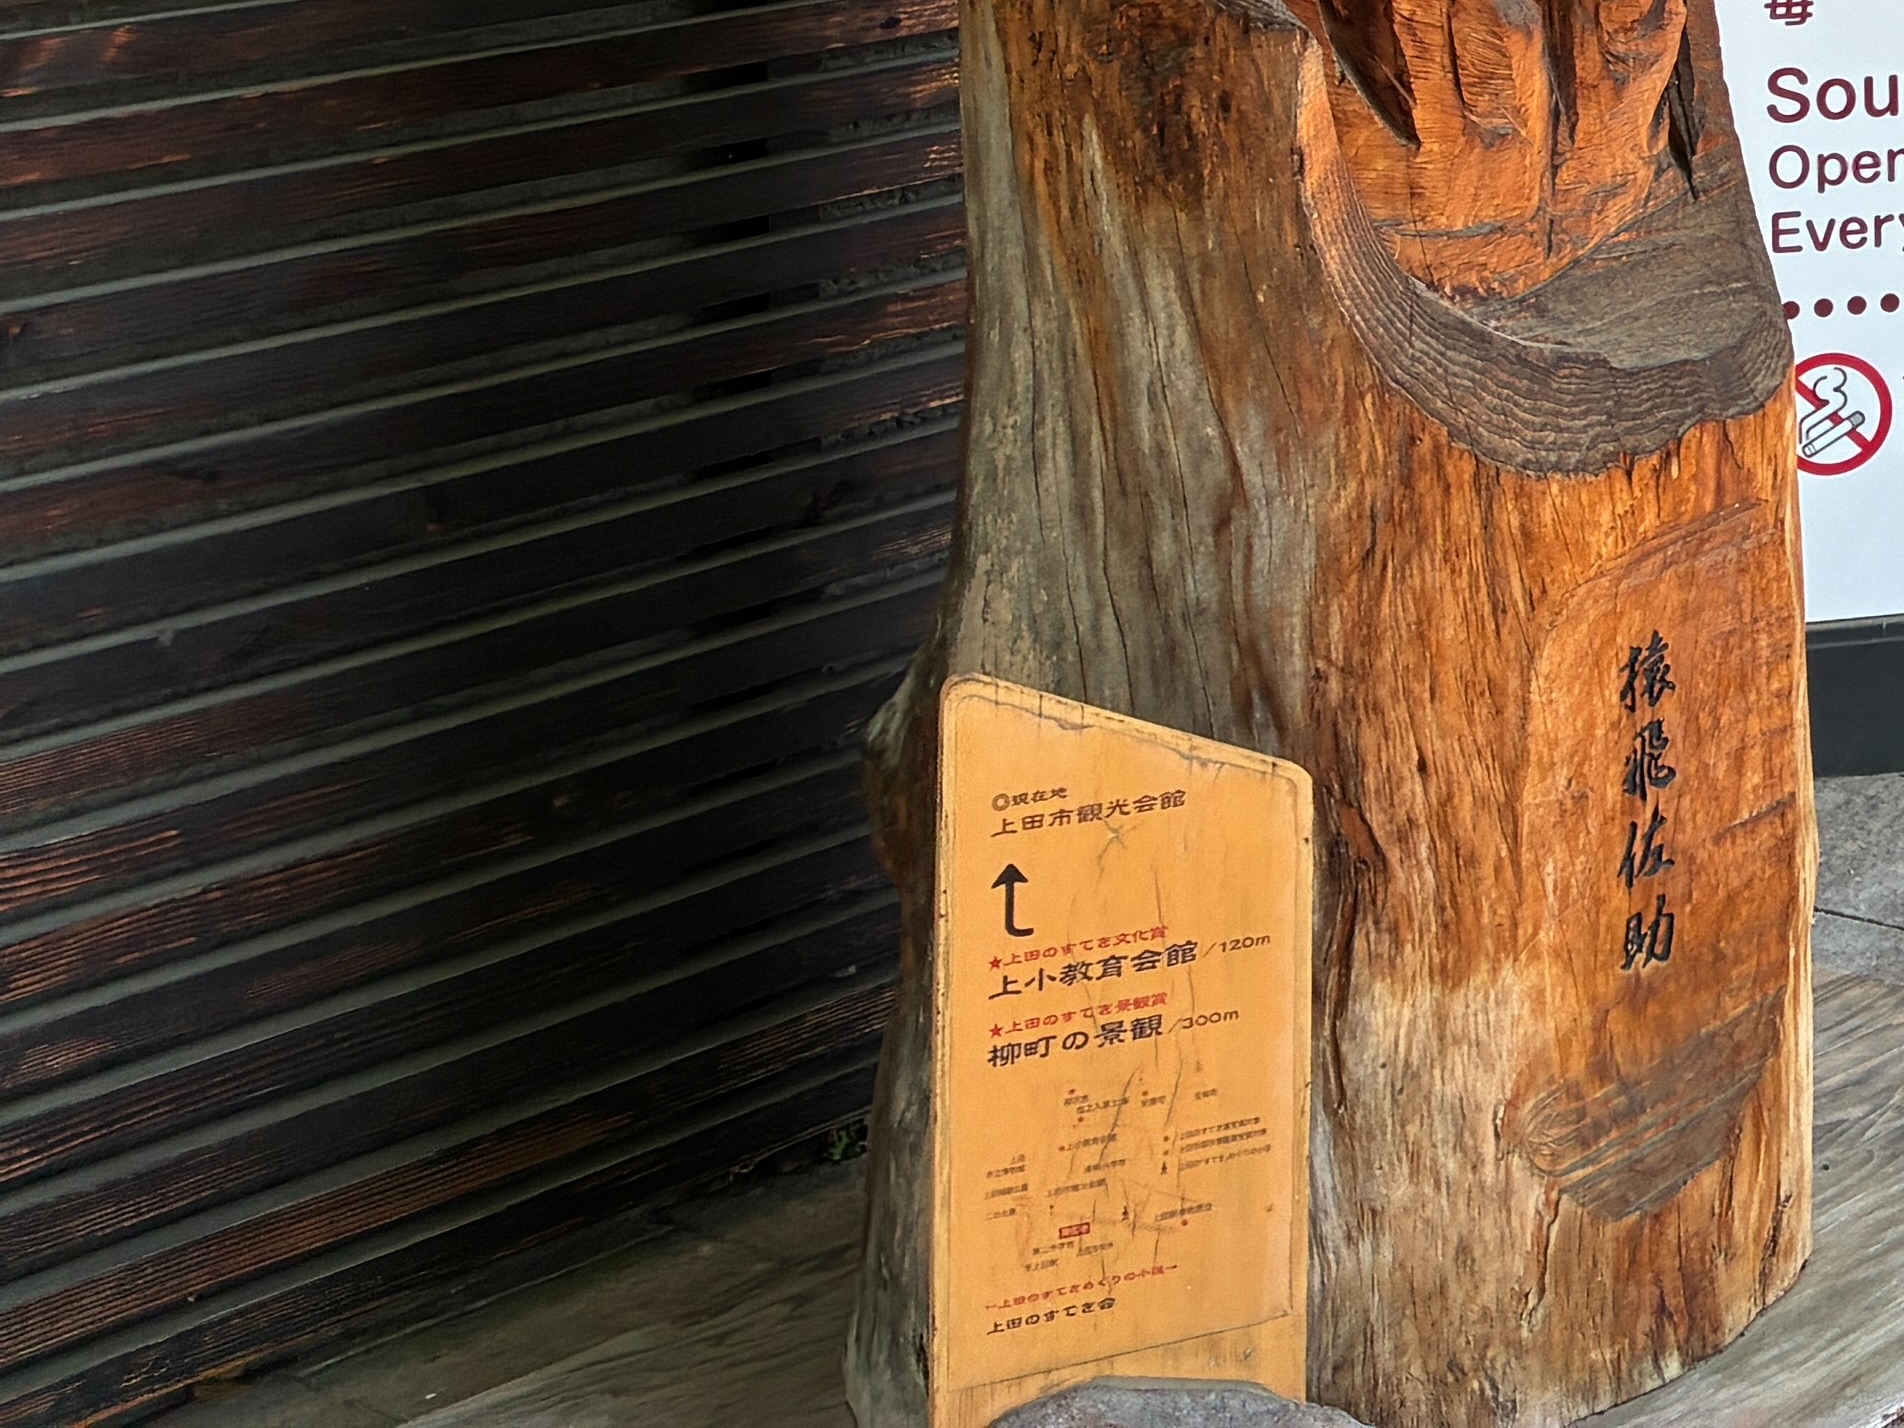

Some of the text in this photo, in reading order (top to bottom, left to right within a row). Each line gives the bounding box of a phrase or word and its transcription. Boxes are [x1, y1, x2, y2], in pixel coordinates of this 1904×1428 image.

[991, 789, 1186, 837] 上田市観光会館
[1618, 629, 1676, 972] 猿飛佐助
[988, 940, 1198, 1000] 上小教育会館
[988, 1014, 1163, 1067] 柳町の景観
